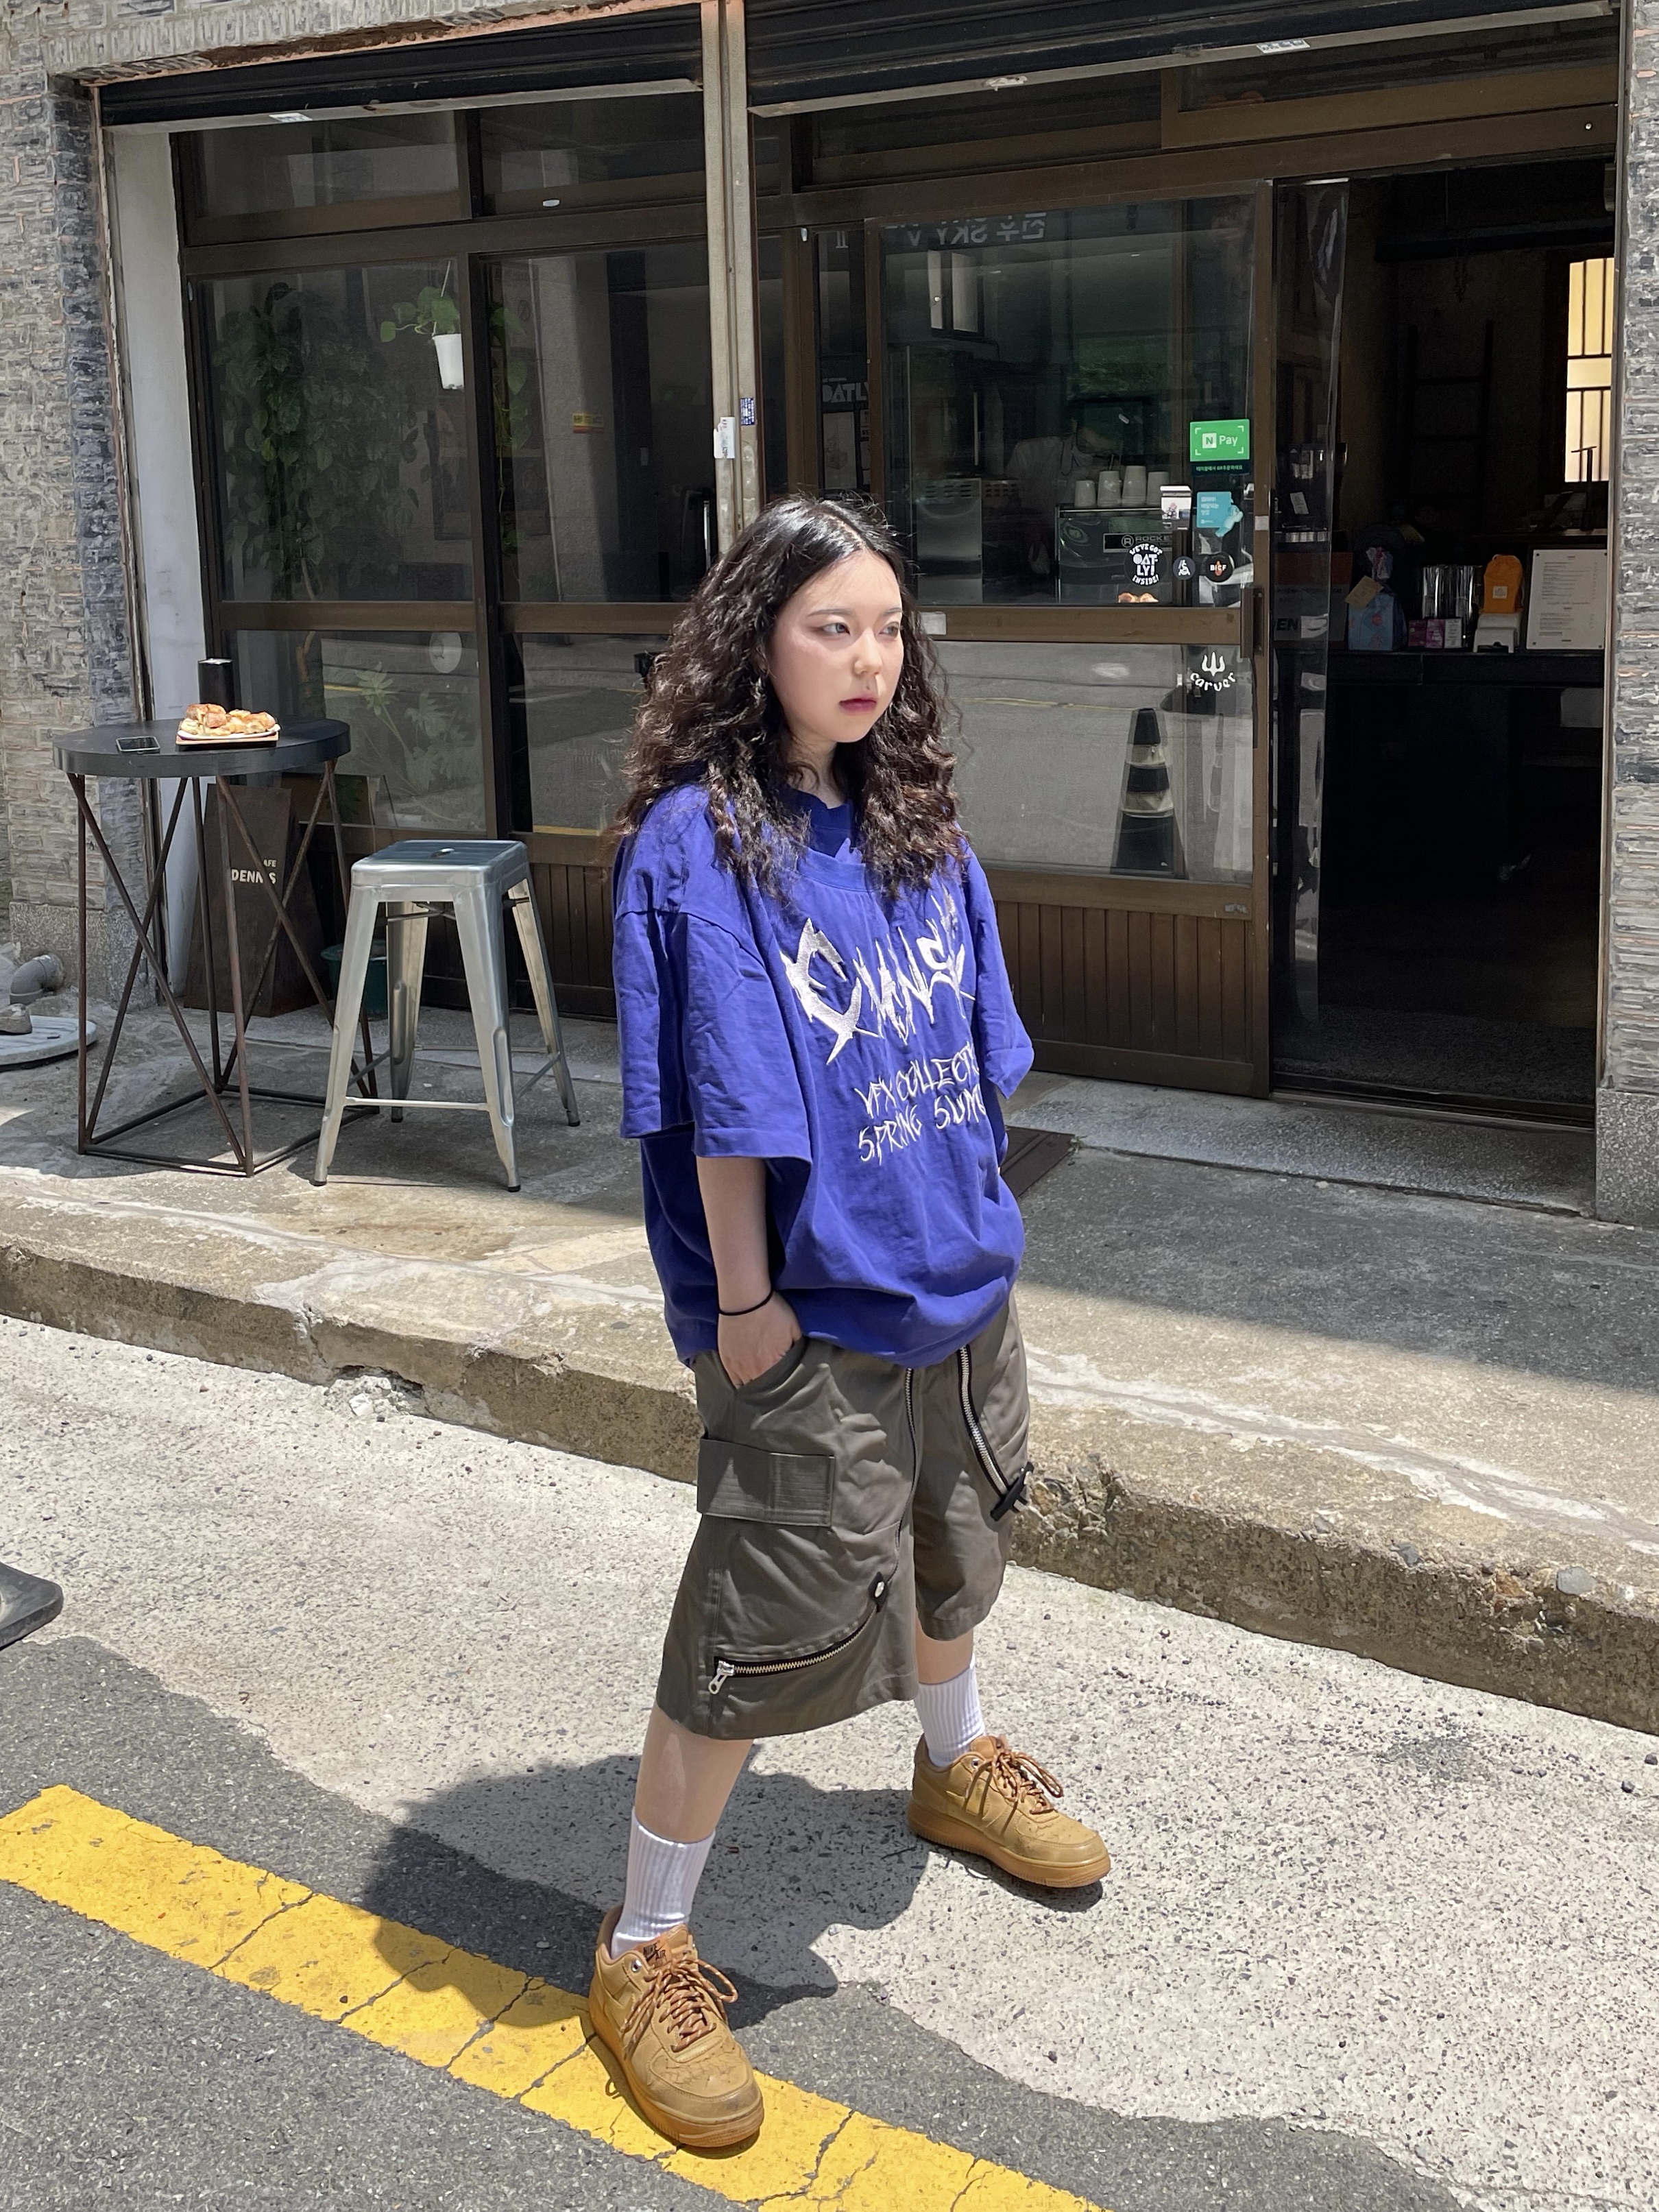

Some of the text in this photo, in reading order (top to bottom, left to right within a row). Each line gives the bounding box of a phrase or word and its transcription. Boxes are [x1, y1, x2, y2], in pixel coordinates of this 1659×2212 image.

[822, 382, 869, 403] OATL
[1219, 435, 1238, 446] Pay
[1150, 544, 1163, 555] GOT
[1137, 565, 1155, 576] LY!
[1132, 574, 1160, 586] INSIDE!
[1190, 672, 1236, 692] carver
[263, 859, 276, 867] AFE
[231, 868, 276, 885] DENNS
[858, 1105, 923, 1166] SPRING
